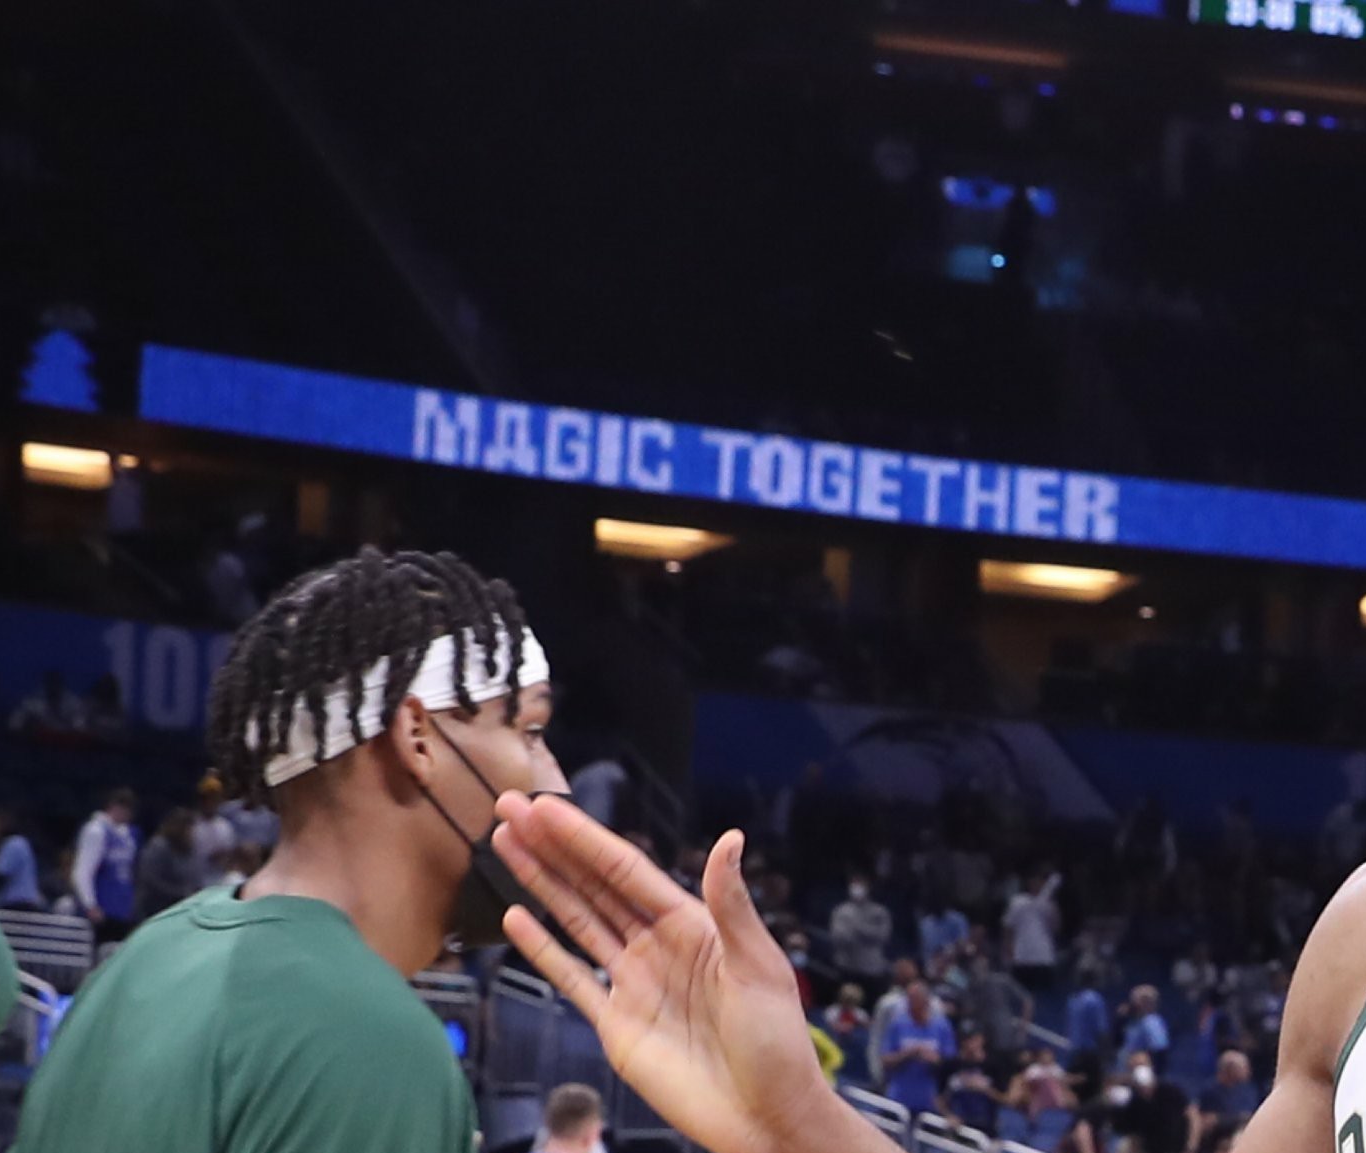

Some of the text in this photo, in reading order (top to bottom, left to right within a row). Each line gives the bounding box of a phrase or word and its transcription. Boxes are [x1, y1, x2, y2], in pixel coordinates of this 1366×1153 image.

[412, 388, 1121, 545] MAGIC TOGETHER
[103, 620, 235, 730] 10
